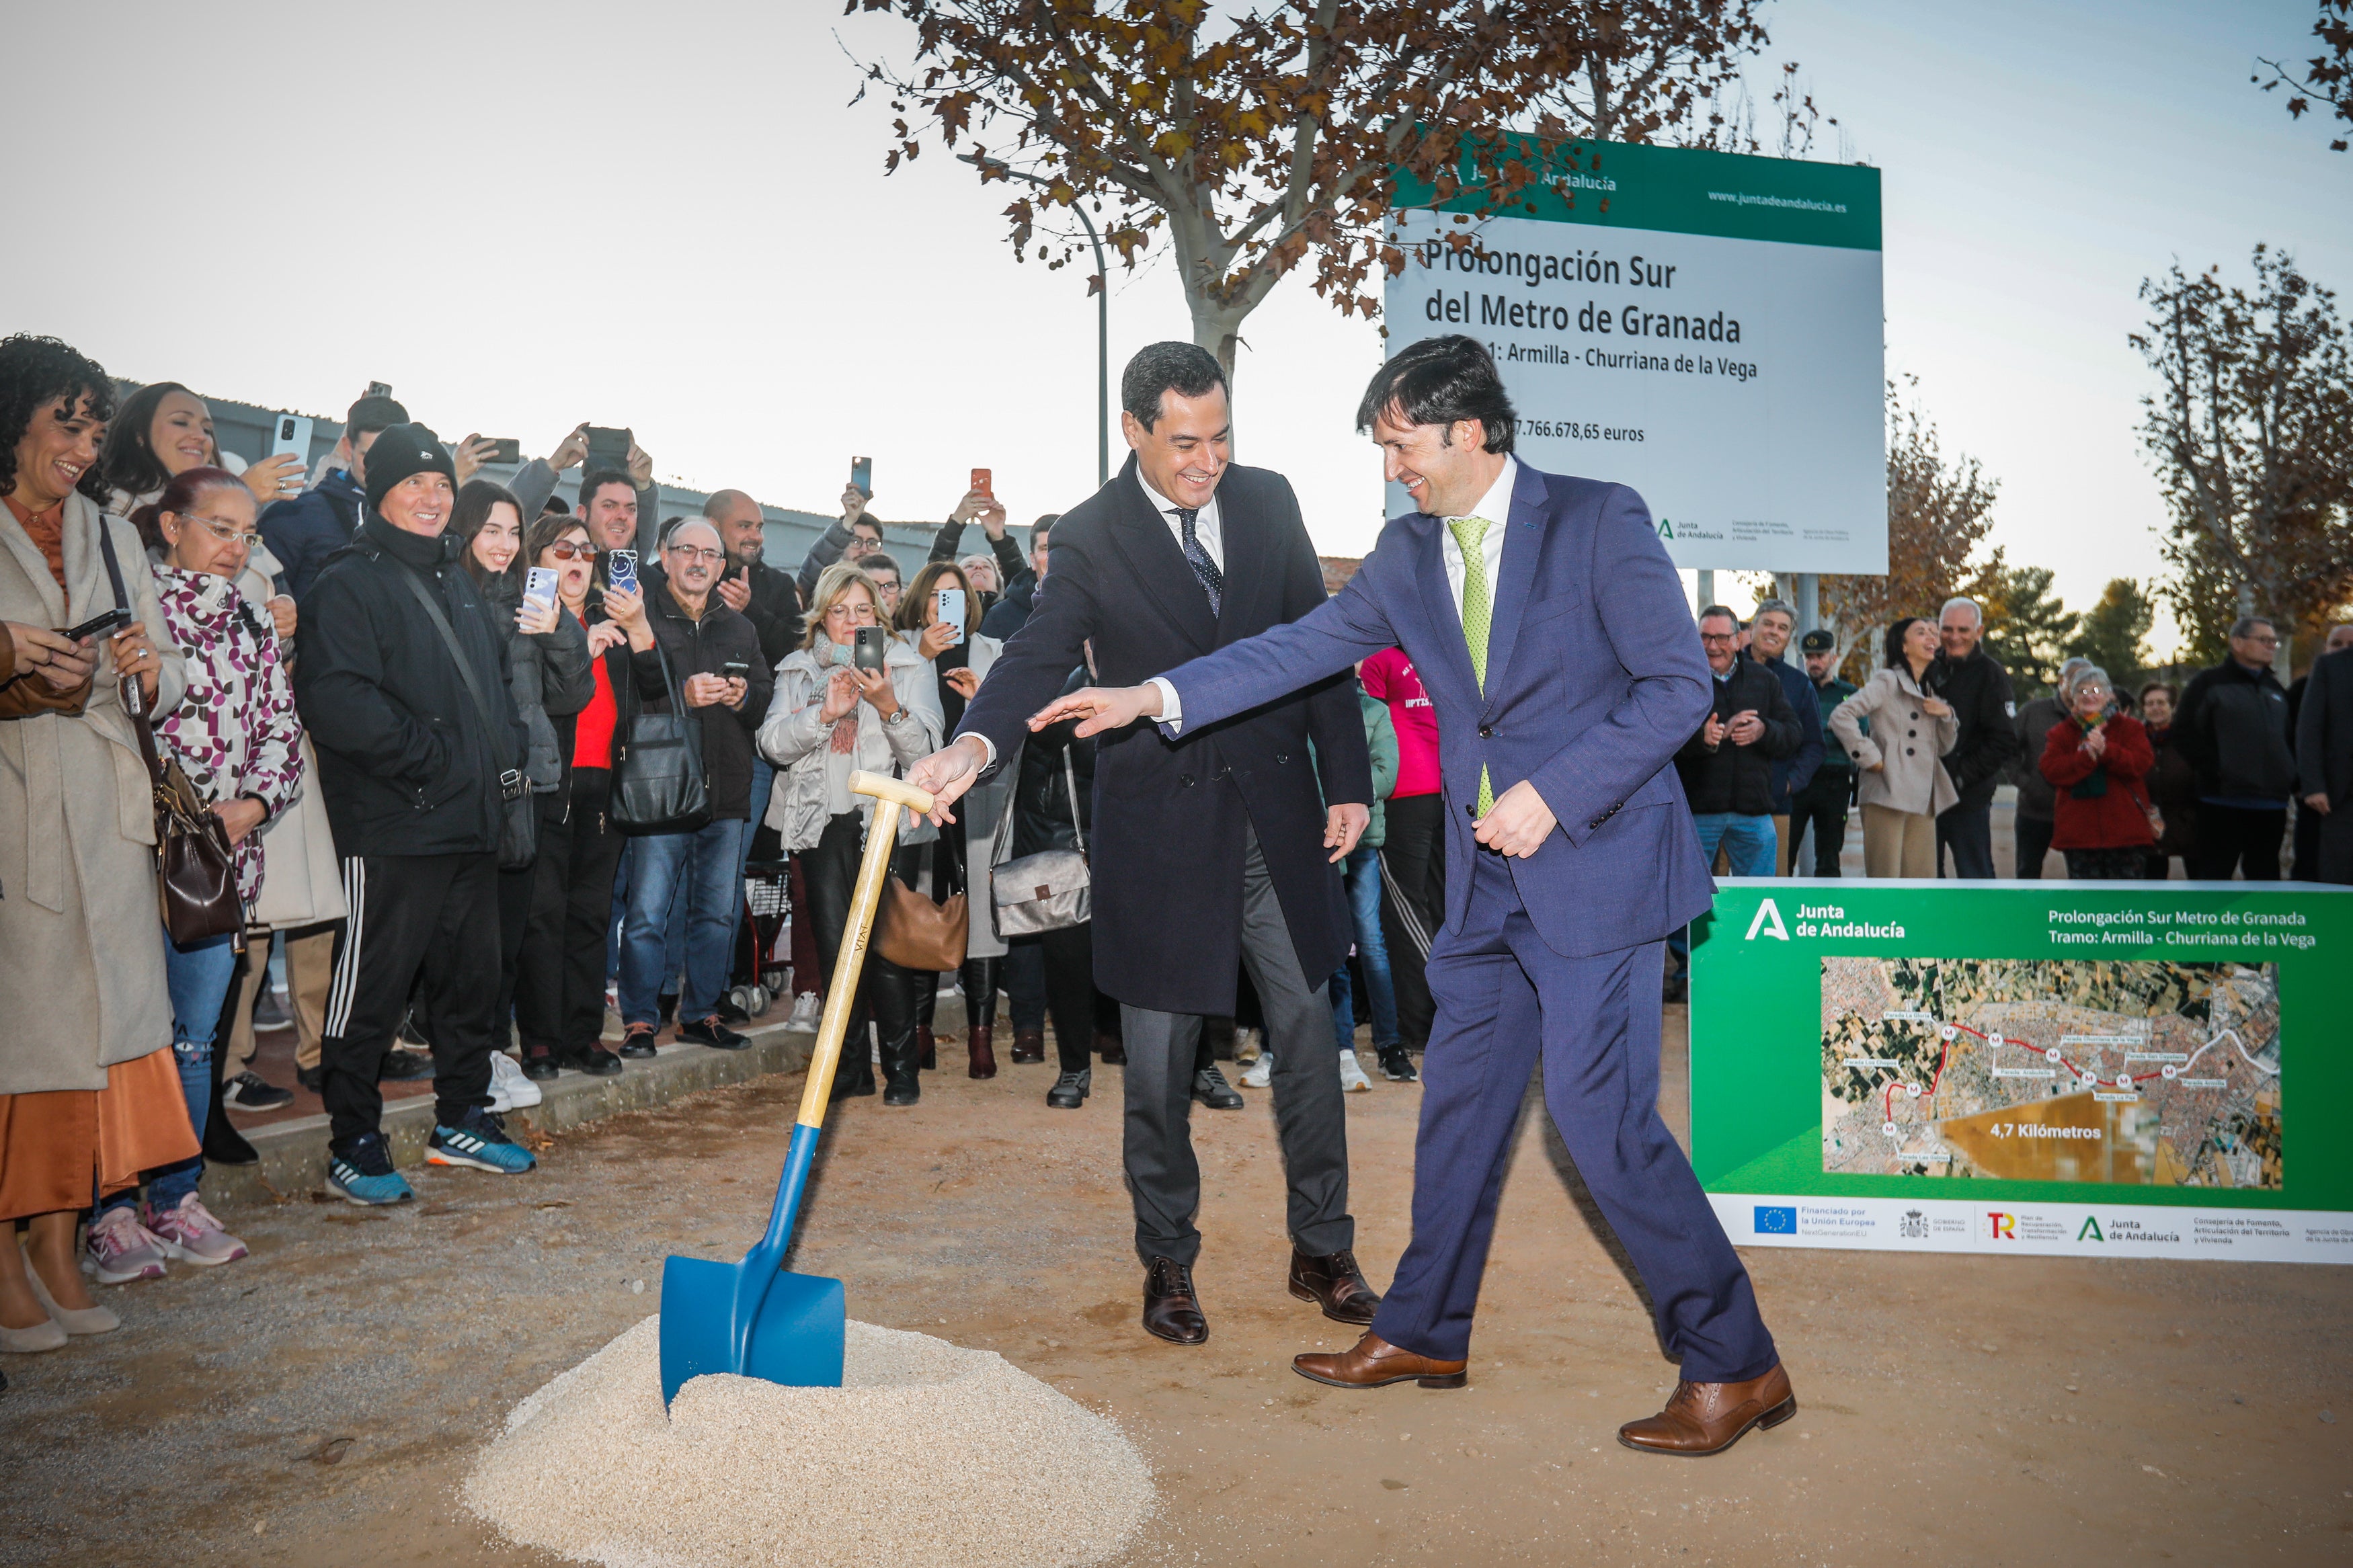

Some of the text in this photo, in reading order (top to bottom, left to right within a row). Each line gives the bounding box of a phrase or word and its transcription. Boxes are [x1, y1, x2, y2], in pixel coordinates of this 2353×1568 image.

[1708, 191, 1847, 214] www.juntadeandalucia.es
[1426, 238, 1677, 289] Prolongación Sur
[1425, 288, 1741, 343] del Metro de Granada
[1488, 341, 1502, 361] 1:
[1507, 342, 1569, 365] Armilla
[1585, 347, 1670, 372] Churriana
[1674, 353, 1695, 374] de
[1698, 355, 1713, 375] la
[1717, 357, 1758, 382] Vega
[1603, 427, 1645, 442] euros
[1677, 521, 1698, 530] Junta
[1677, 530, 1724, 540] de Andalucía
[1796, 903, 1845, 919] Junta
[2048, 909, 2307, 927] Prolongación Sur Metro de Granada
[1796, 920, 1906, 939] de Andalucía
[2048, 930, 2099, 944] Tramo:
[2102, 930, 2153, 944] Armilla
[2165, 931, 2239, 946] Churriana
[2241, 931, 2260, 946] de
[2264, 931, 2278, 946] la
[2280, 932, 2317, 950] Vega
[1990, 1122, 2102, 1139] 4,7 Kilómetros
[1802, 1206, 1866, 1216] Financiado por
[1811, 1217, 1837, 1226] Unión
[1839, 1219, 1876, 1227] Europea
[2109, 1219, 2141, 1229] Junta
[2193, 1216, 2234, 1227] Consejería
[2235, 1218, 2245, 1227] de
[1802, 1229, 1867, 1237] NextGenerationEU
[2109, 1231, 2180, 1242] de Andalucía
[2193, 1227, 2290, 1237] Articulación del Territorio
[2200, 1236, 2233, 1244] Vivienda
